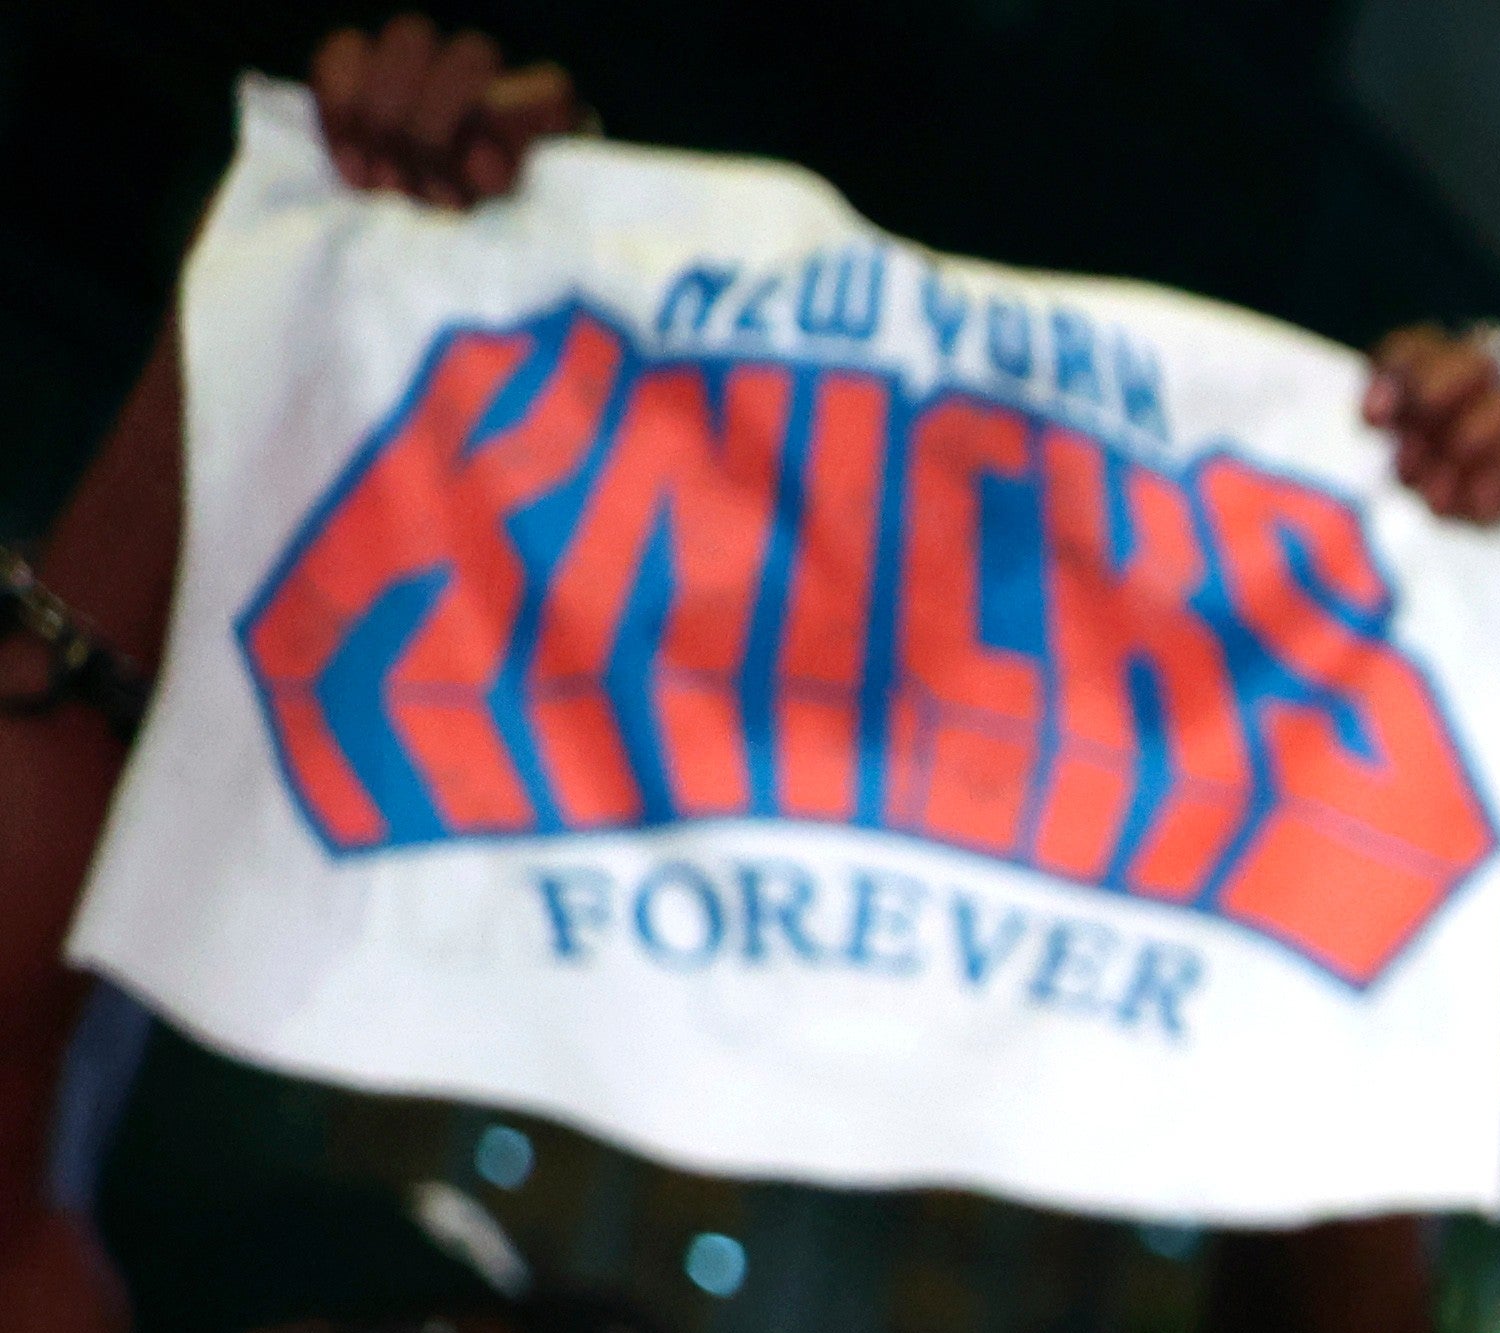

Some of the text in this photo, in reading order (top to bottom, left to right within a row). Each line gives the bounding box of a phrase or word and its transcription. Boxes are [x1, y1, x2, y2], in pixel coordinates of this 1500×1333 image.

[653, 244, 1170, 442] NEW YORK
[236, 288, 1500, 993] KNICKS
[533, 860, 1211, 1040] FOREVER
